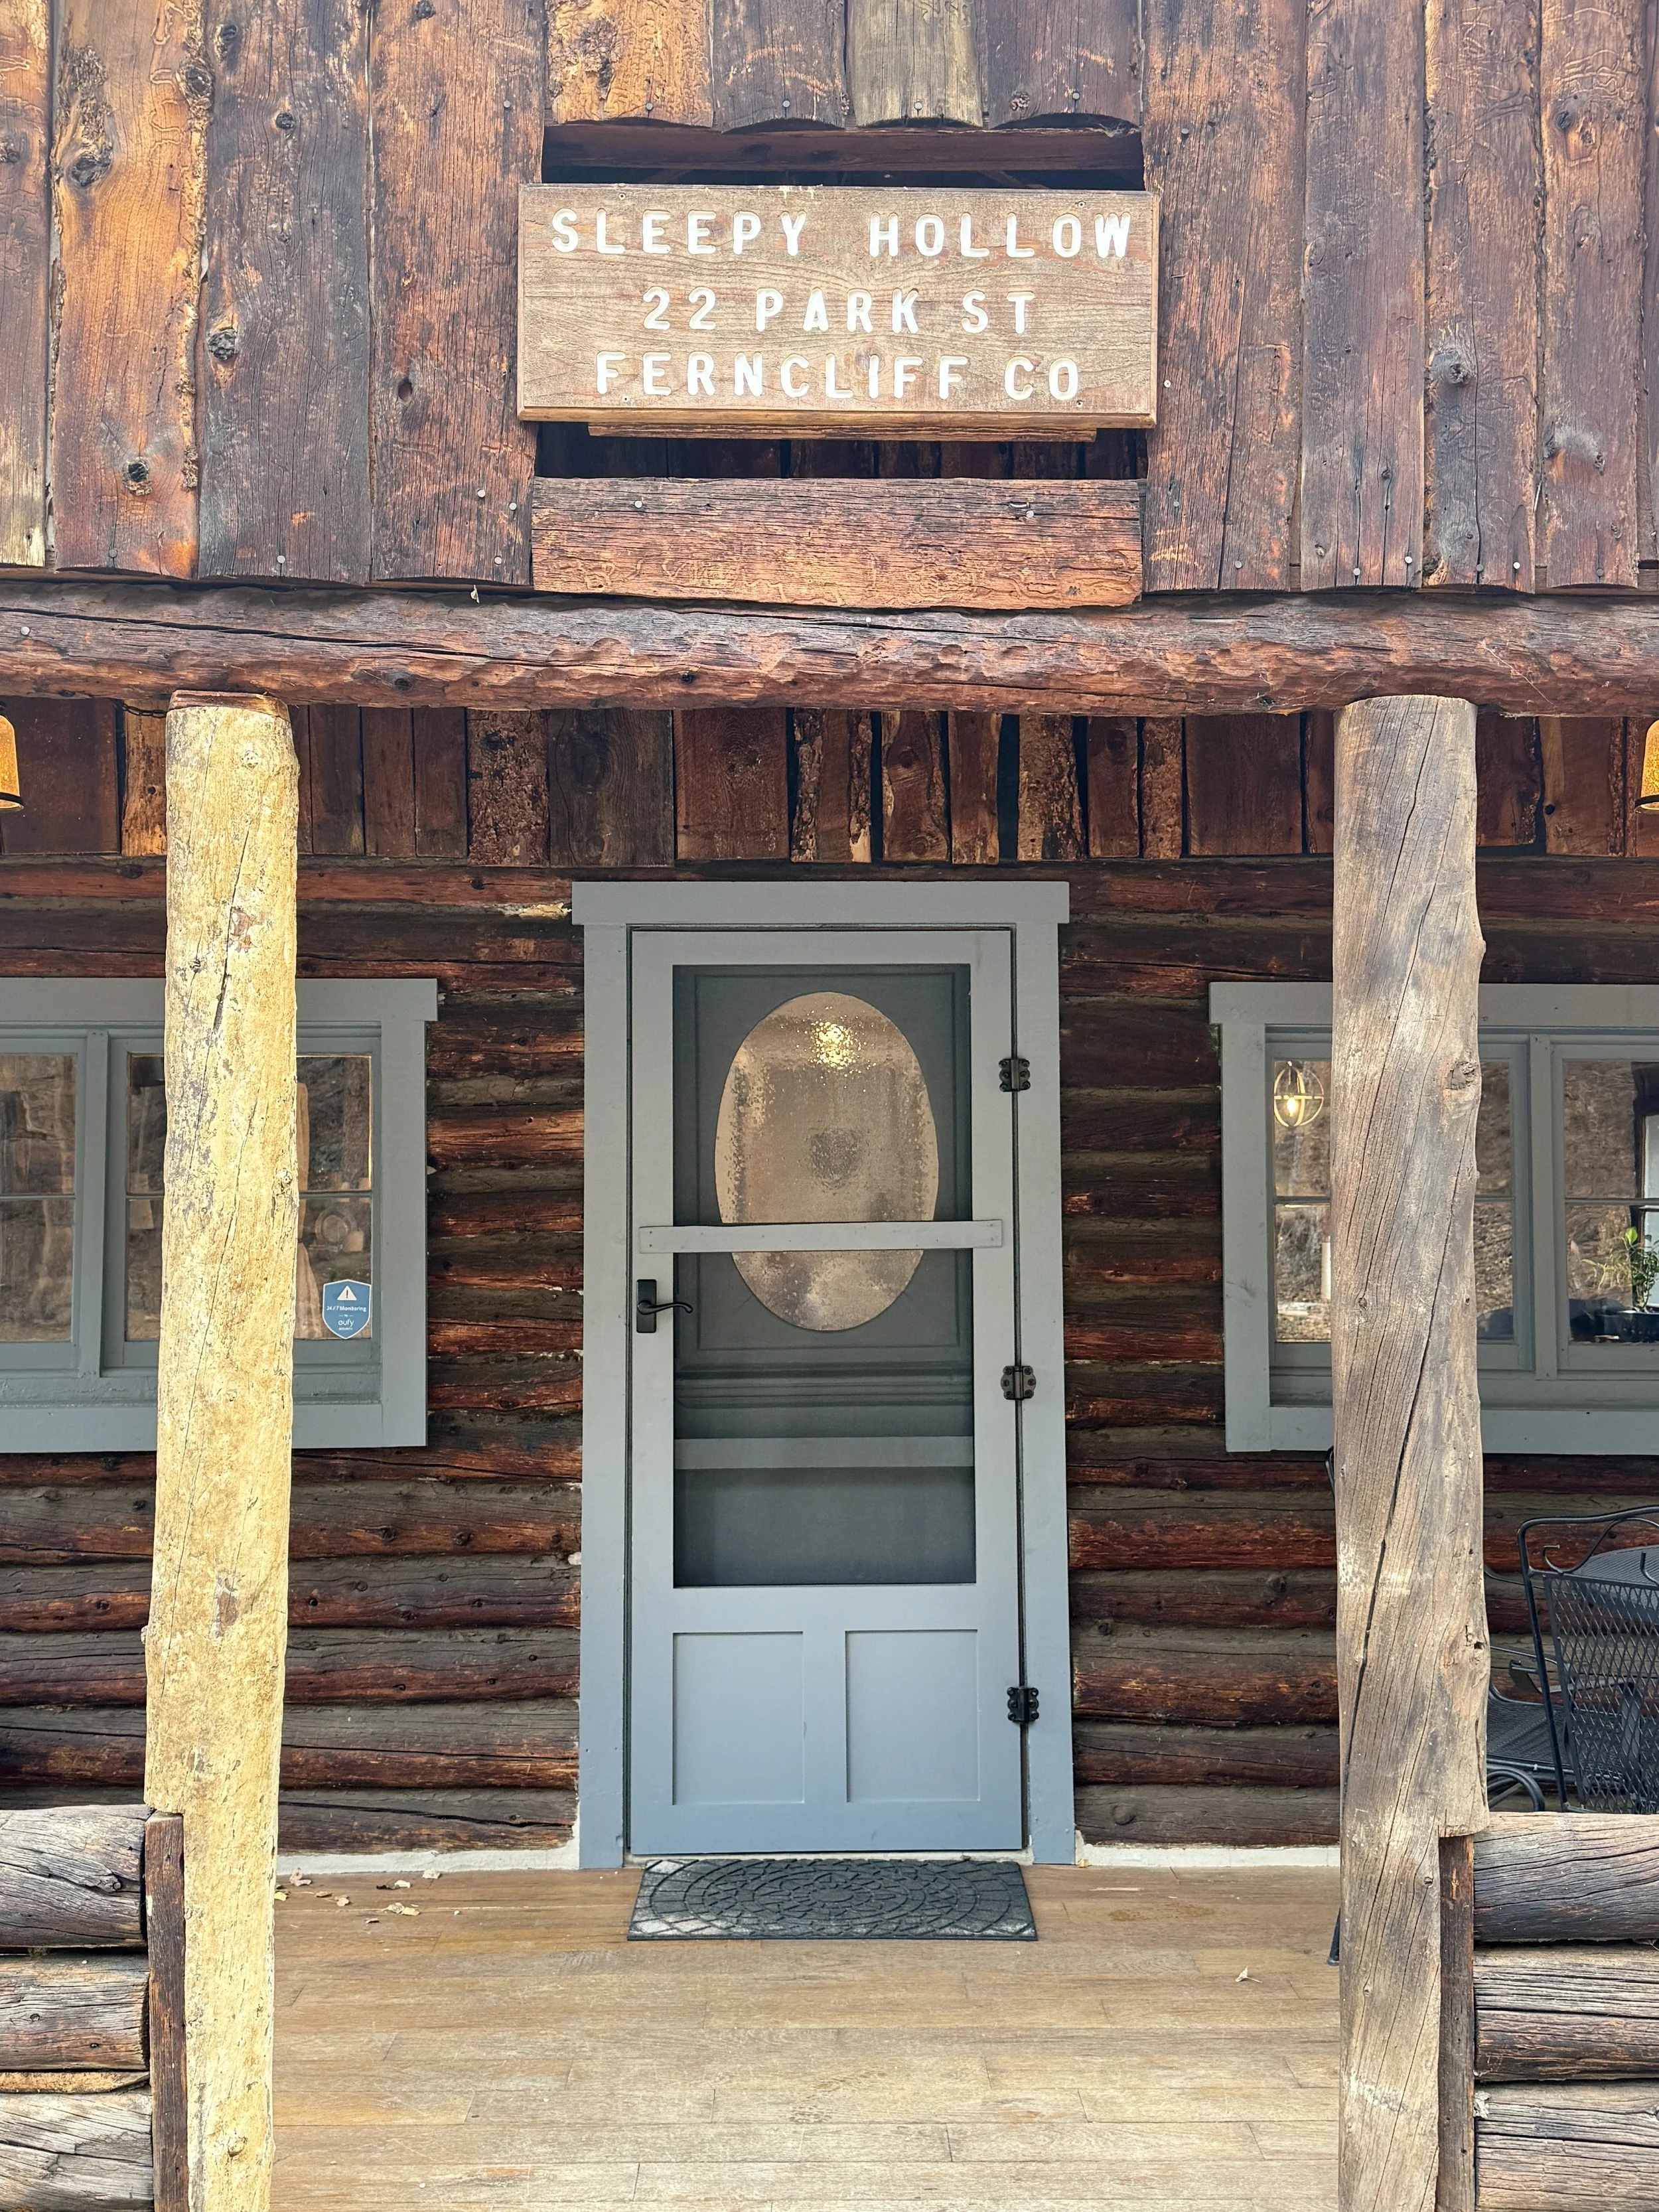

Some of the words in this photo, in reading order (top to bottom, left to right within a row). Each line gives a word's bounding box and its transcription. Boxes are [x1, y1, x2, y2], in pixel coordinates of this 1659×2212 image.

[551, 208, 808, 256] SLEEPY
[869, 212, 1131, 258] HOLLOW
[642, 285, 717, 331] 22
[756, 287, 920, 334] PARK
[961, 289, 1035, 334] ST
[596, 351, 969, 400] FERNCLIFF
[1004, 356, 1079, 400] CO
[338, 1319, 354, 1327] eufy
